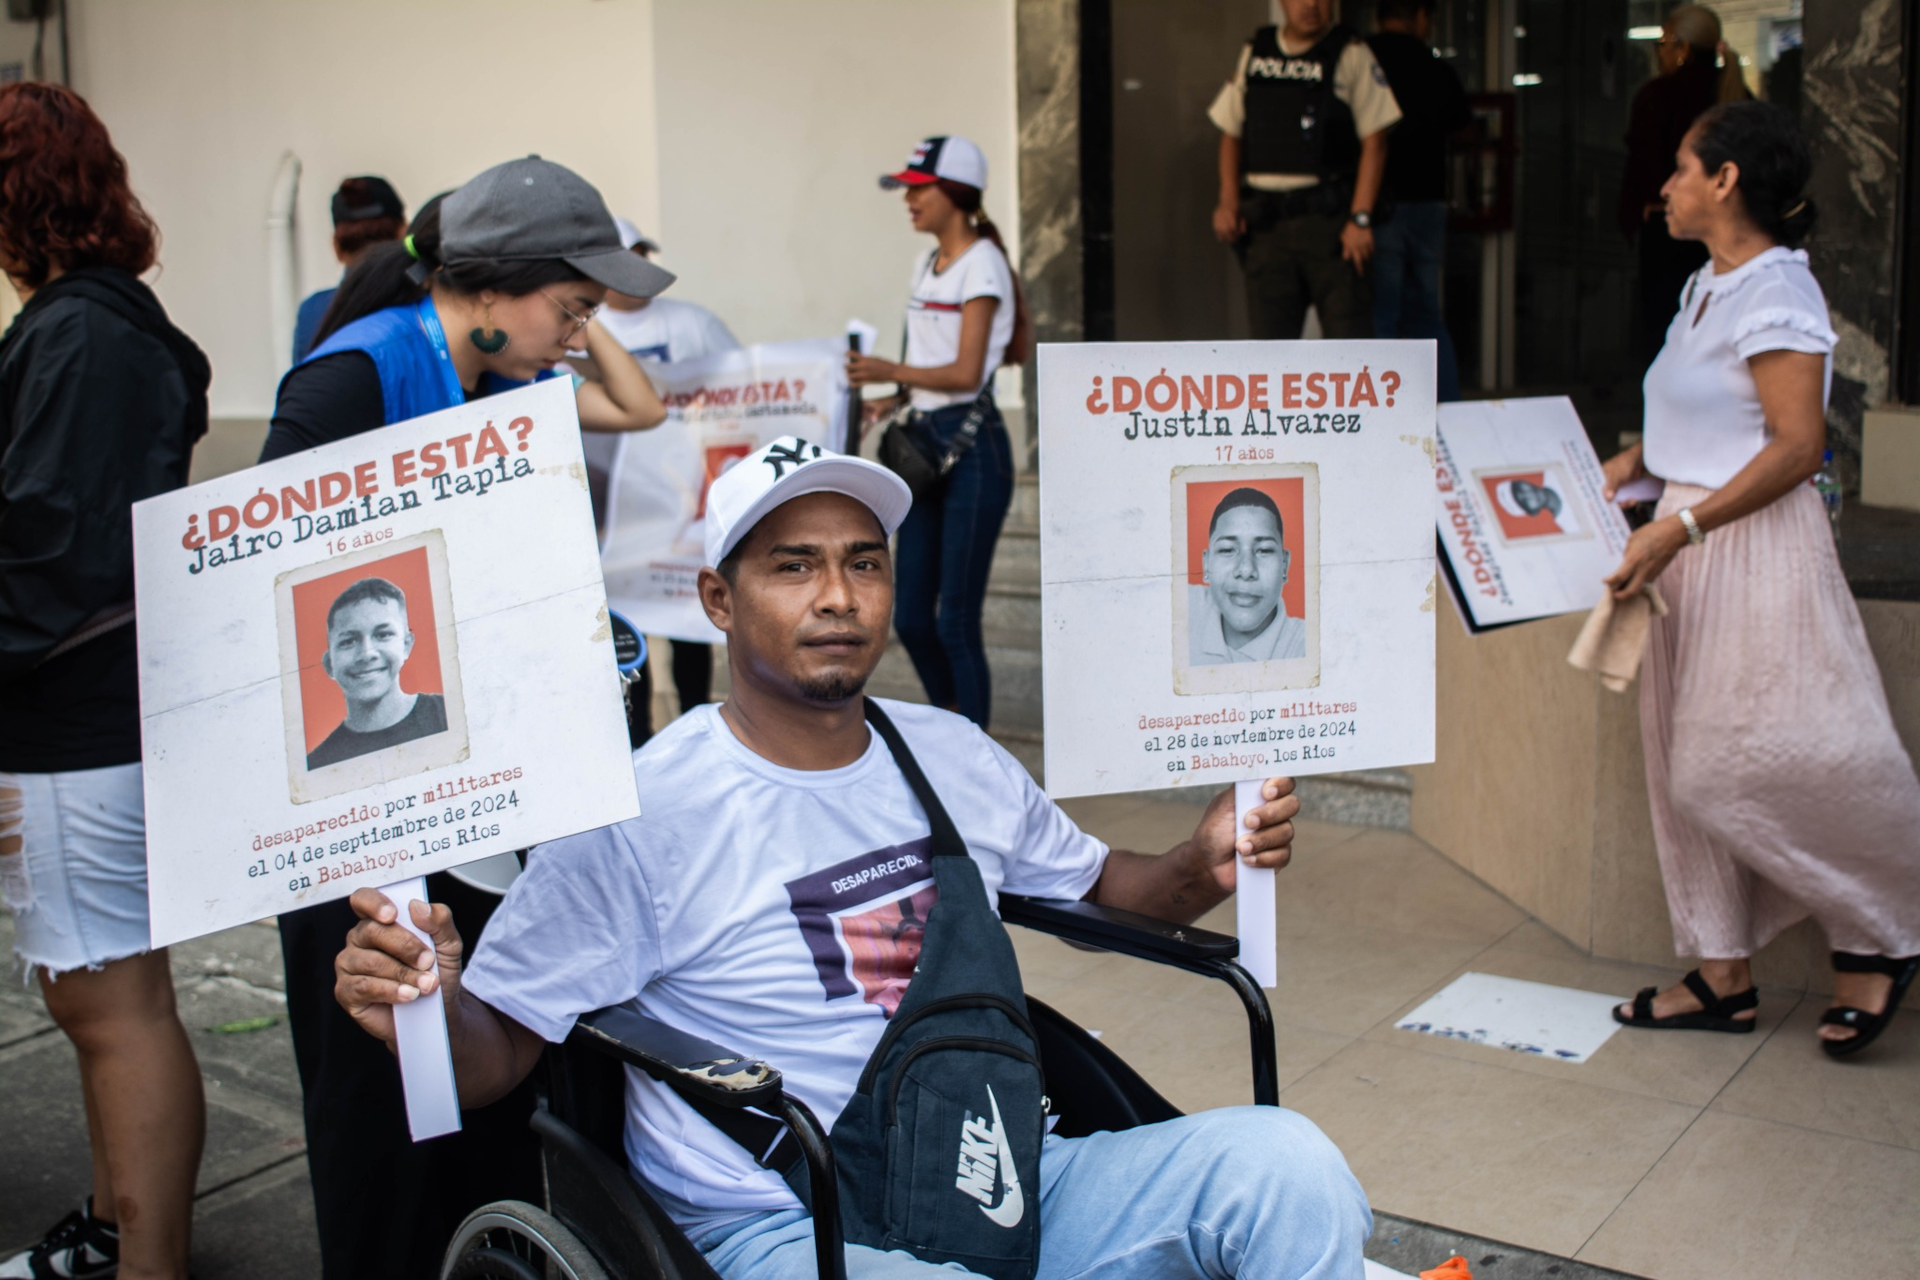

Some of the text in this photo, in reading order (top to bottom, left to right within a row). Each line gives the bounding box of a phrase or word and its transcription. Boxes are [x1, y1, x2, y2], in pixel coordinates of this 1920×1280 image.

[1249, 57, 1323, 81] POLICIA
[1086, 366, 1401, 415] ¿DÓNDE ESTÁ?
[1125, 409, 1361, 440] Justin Alvarez
[1215, 446, 1274, 461] 17 años
[182, 416, 534, 550] ¿DÓNDE ESTÁ?
[189, 456, 535, 574] Jairo Damian Tapia
[326, 527, 394, 556] 16 años
[1139, 702, 1357, 730] desaparecido por militares
[1144, 721, 1356, 751] el 28 de noviembre de 2024
[1167, 759, 1186, 771] en
[1191, 751, 1268, 770] Babahoyo,
[1273, 748, 1297, 763] los
[252, 767, 523, 851] desaparecido por militares
[248, 790, 519, 877] el 04 de septiembre de 2024
[289, 873, 312, 891] en
[317, 849, 414, 884] Babahoyo,
[420, 836, 450, 856] los
[956, 1110, 1001, 1206] NIKE
